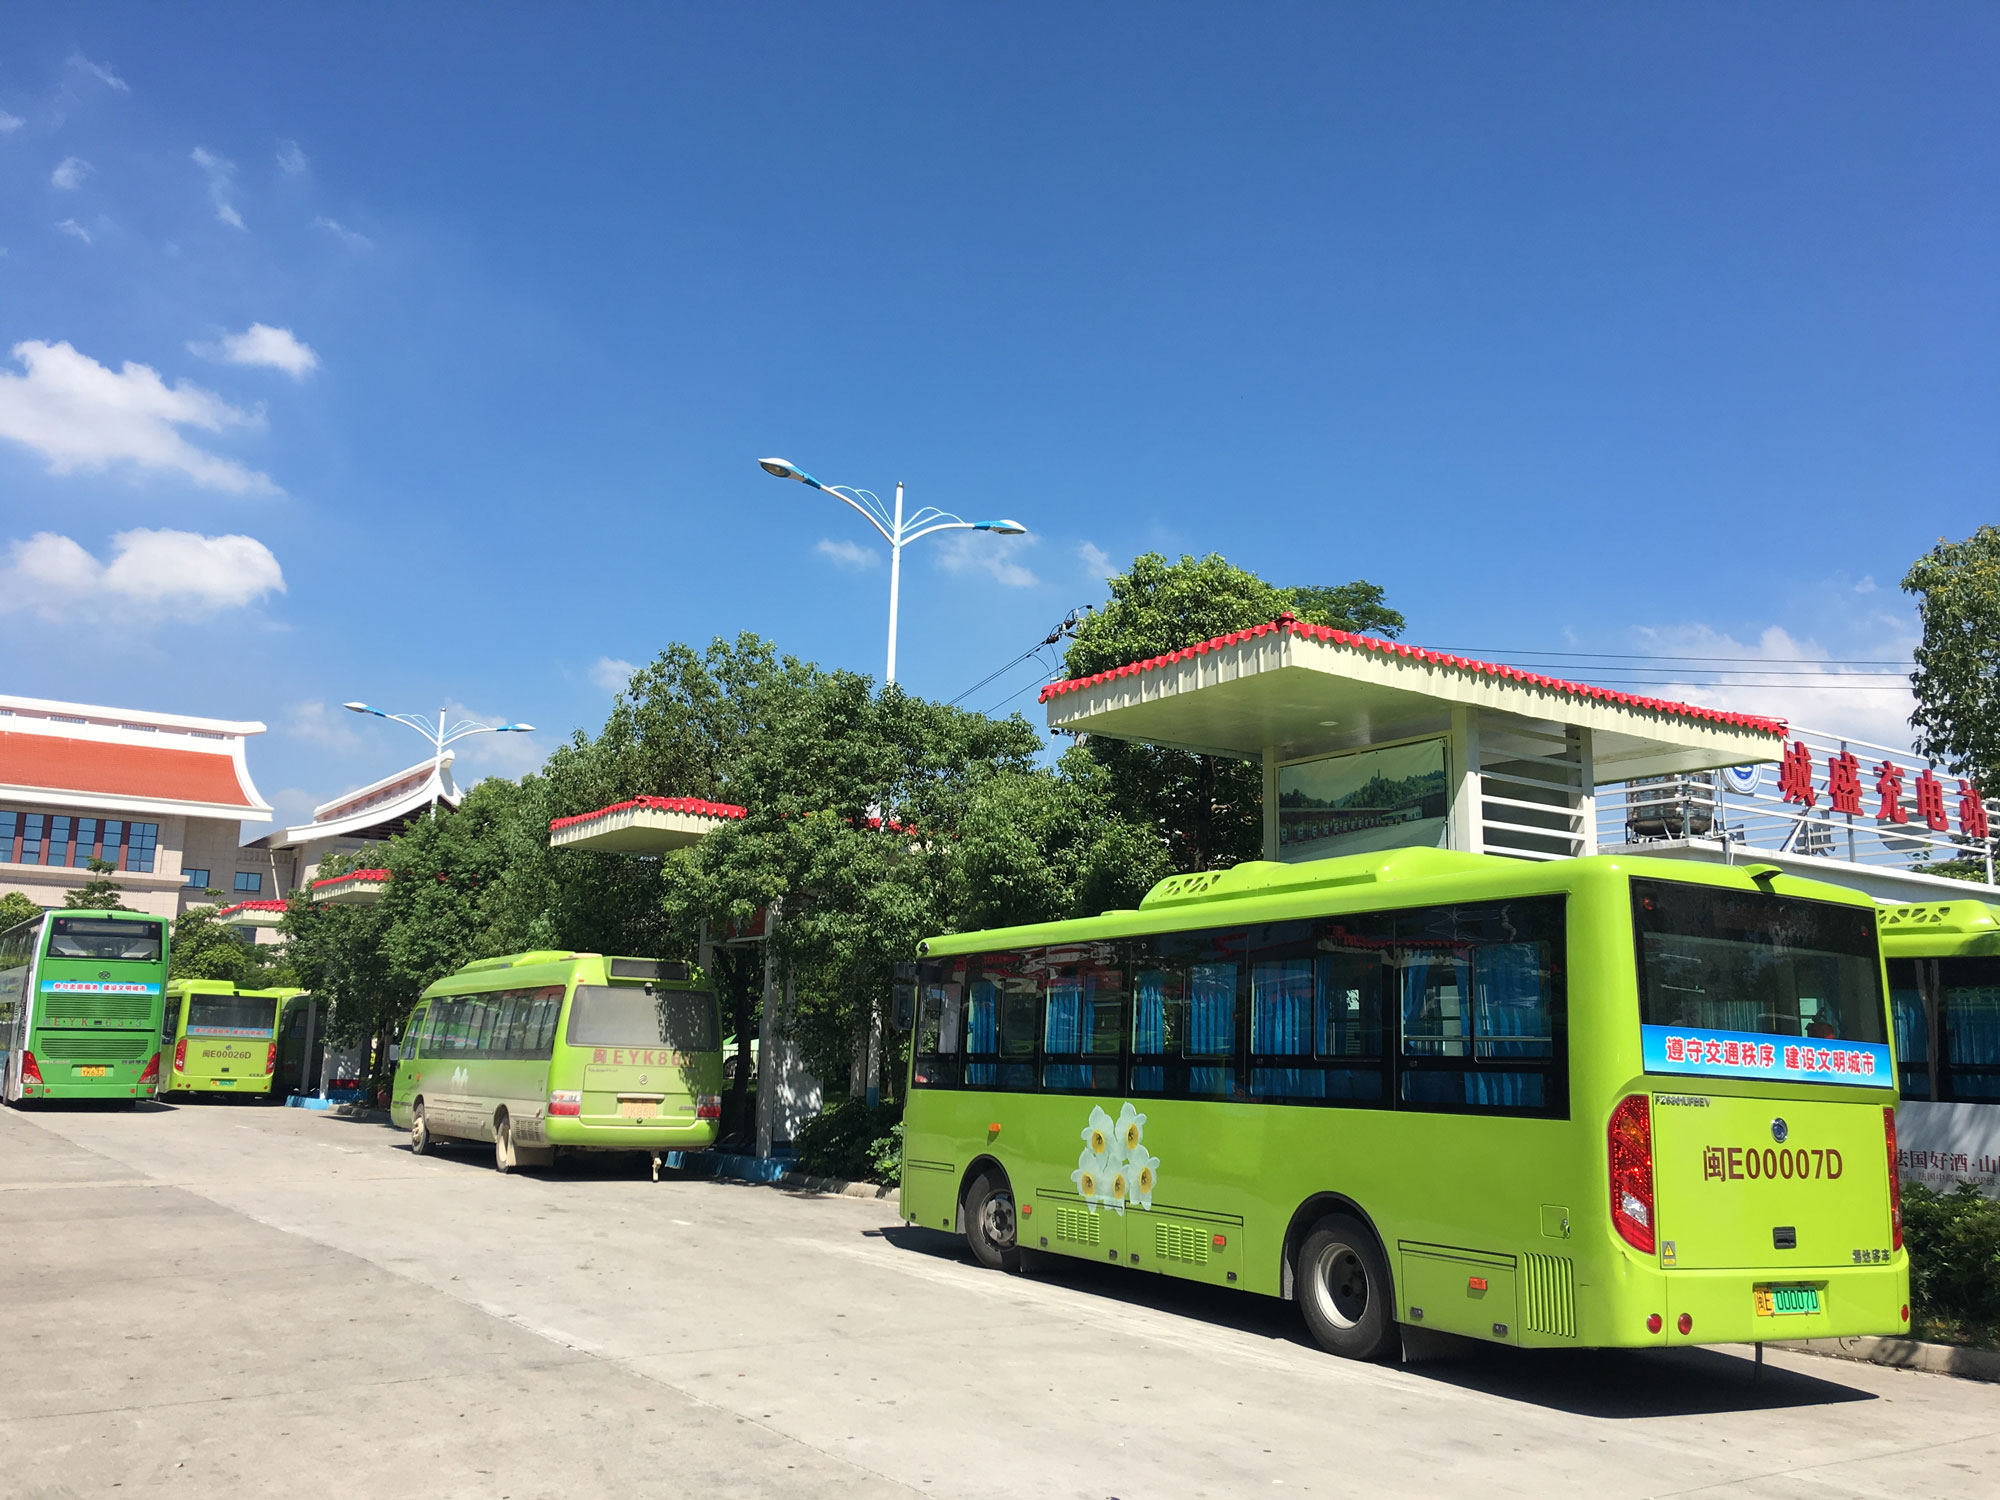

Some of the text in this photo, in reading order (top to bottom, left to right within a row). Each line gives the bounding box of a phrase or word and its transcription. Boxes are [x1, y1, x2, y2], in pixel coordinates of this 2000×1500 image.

[1777, 740, 1989, 838] 城盛充电站
[202, 1049, 251, 1060] 闽E00026D
[1666, 1036, 1875, 1075] 遵守交通秩序 建设文明城市
[1703, 1145, 1843, 1183] 闽E00007D
